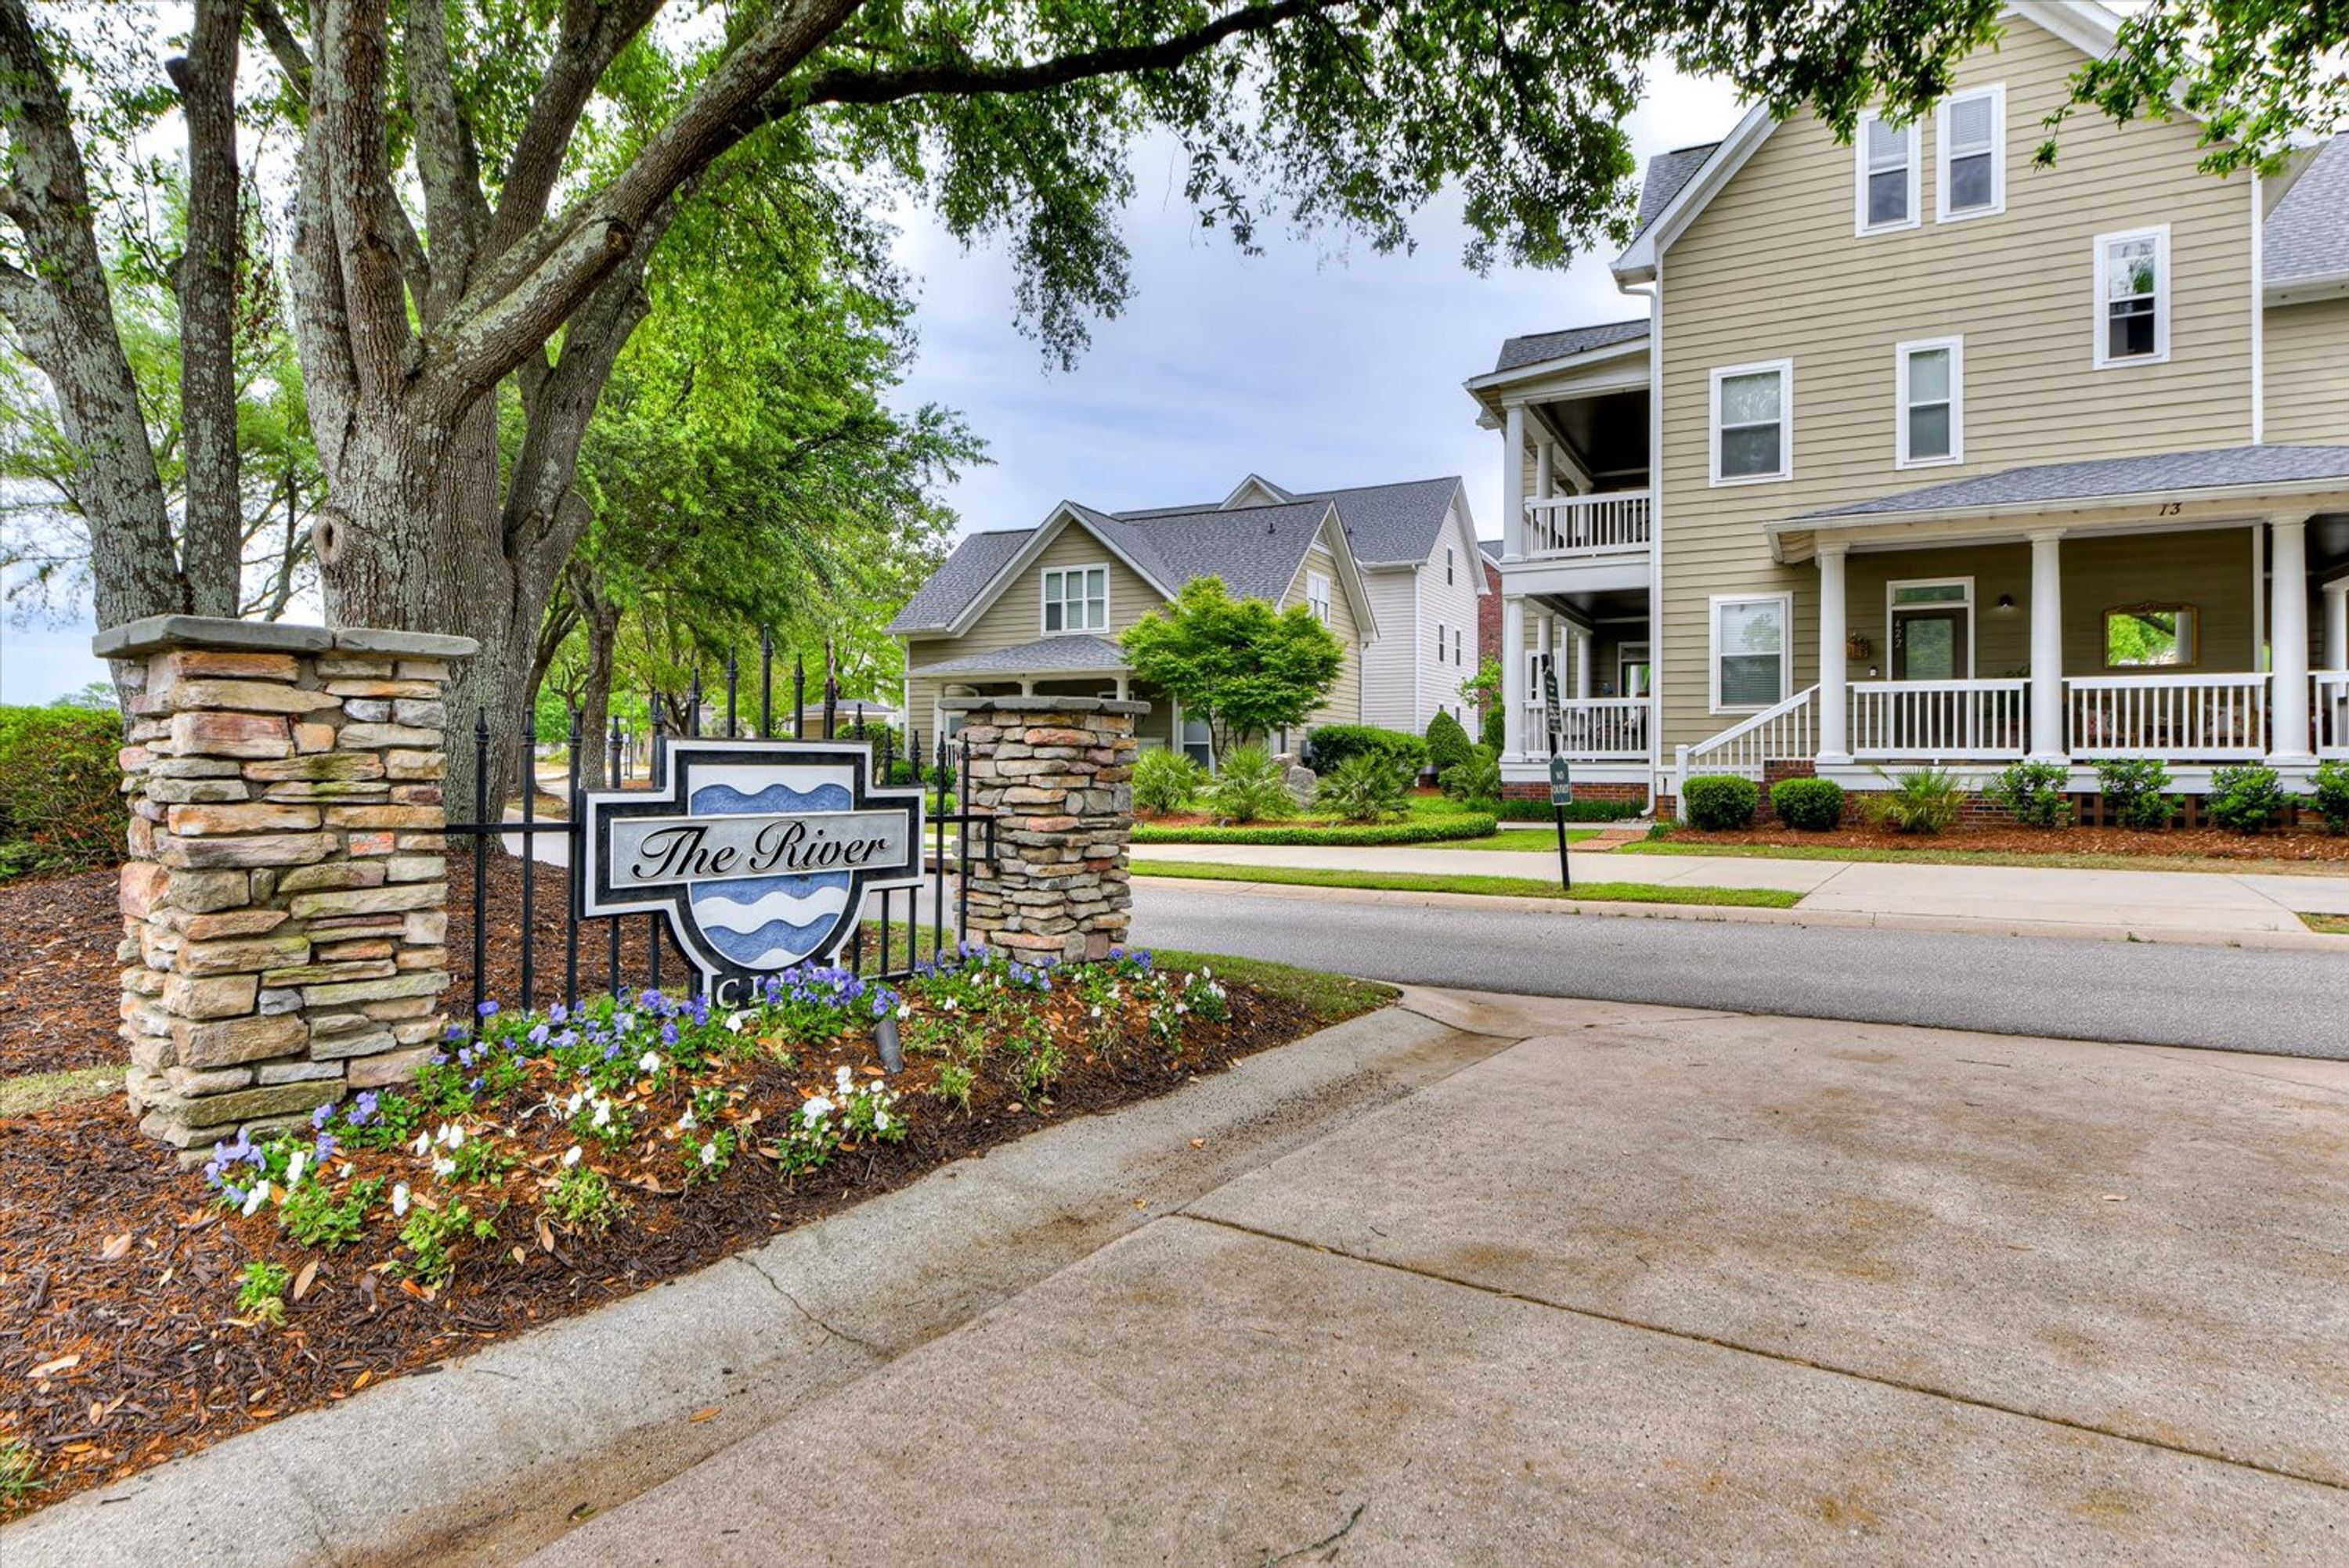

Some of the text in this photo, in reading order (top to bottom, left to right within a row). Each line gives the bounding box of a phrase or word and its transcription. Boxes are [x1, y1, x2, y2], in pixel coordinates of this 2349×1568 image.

[2159, 501, 2182, 516] 13
[1556, 770, 1564, 780] NO
[632, 820, 887, 878] The River
